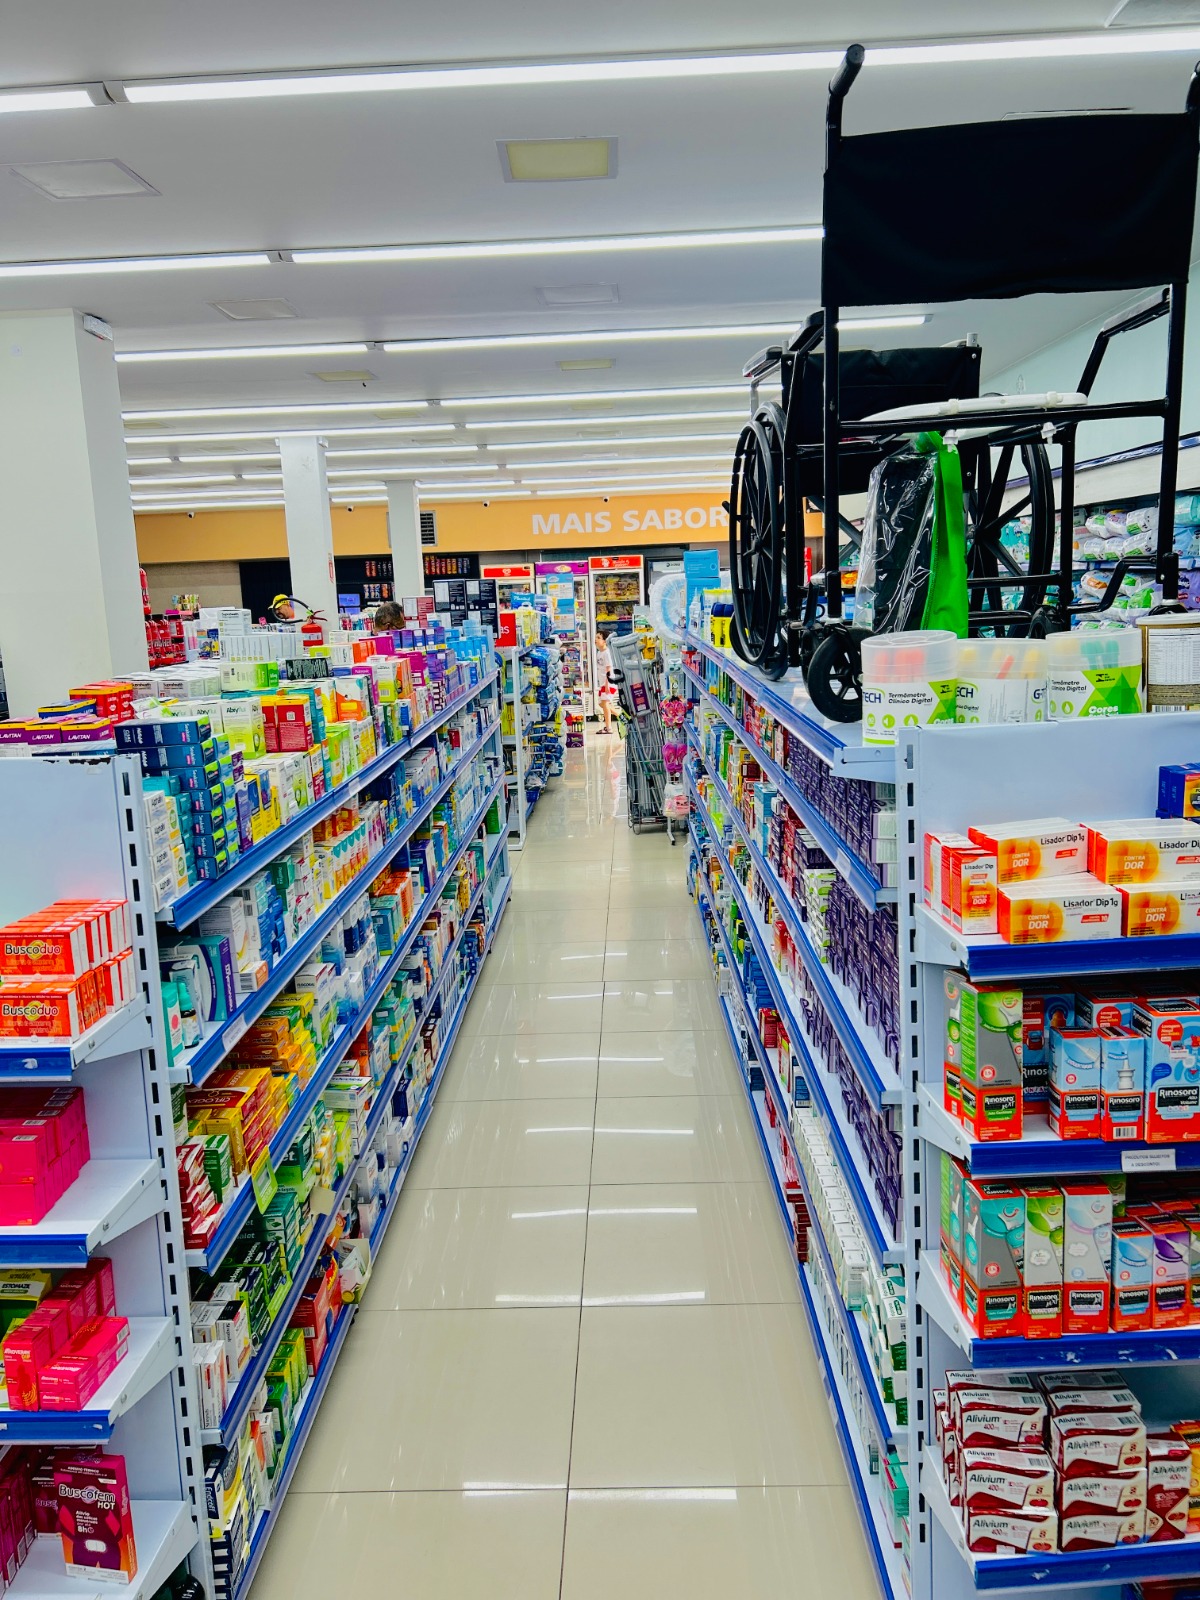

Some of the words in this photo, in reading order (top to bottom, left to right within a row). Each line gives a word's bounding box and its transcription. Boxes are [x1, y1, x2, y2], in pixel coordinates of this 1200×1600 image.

[532, 511, 611, 535] MAIS
[623, 506, 729, 532] SABOR
[911, 697, 933, 705] Digital
[1040, 835, 1065, 845] Lisador
[1066, 834, 1078, 842] Dip
[1159, 841, 1189, 849] Lisador
[1012, 858, 1029, 868] DOR
[1124, 861, 1144, 870] DOR
[1063, 899, 1094, 908] Lisador
[1095, 898, 1109, 907] Dip
[1110, 897, 1118, 907] 1g
[1146, 913, 1165, 922] DOR
[1028, 920, 1048, 929] DOR
[4, 943, 61, 955] Buscoduo
[2, 1004, 59, 1016] Buscoduo
[1159, 1088, 1198, 1098] Rinosoro
[984, 1095, 1015, 1105] Rinosoro
[1066, 1094, 1097, 1103] Rinosoro
[1109, 1096, 1141, 1105] Rinosoro
[1119, 1289, 1149, 1298] Rinosoro
[1156, 1285, 1185, 1294] Rinosoro
[986, 1296, 1016, 1304] Rinosoro
[1029, 1294, 1058, 1302] Rinosoro
[1071, 1292, 1102, 1300] Rinosoro
[965, 1414, 1000, 1423] Alivium
[1058, 1416, 1086, 1424] Alivium
[1066, 1440, 1101, 1450] Alivium
[969, 1473, 1006, 1484] Alivium
[1066, 1482, 1101, 1492] Alivium
[59, 1483, 116, 1503] Buscofem
[97, 1501, 116, 1510] HOT
[972, 1519, 1009, 1528] Alivium
